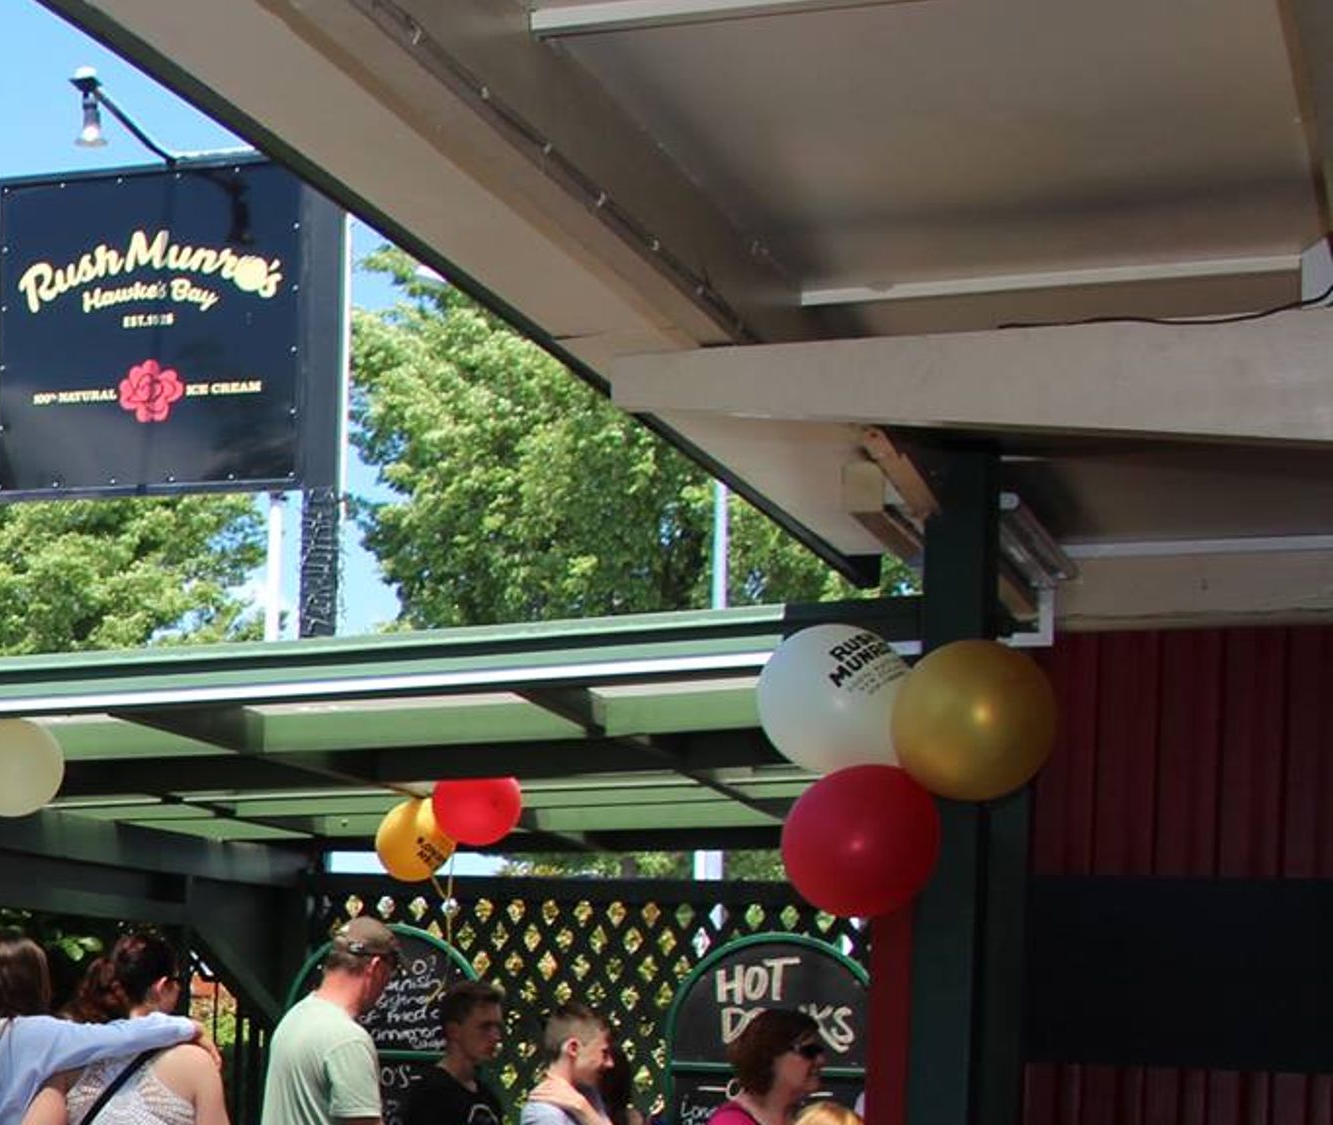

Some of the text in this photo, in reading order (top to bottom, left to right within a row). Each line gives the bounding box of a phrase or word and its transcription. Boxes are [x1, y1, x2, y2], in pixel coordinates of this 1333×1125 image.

[18, 229, 284, 314] Rush Munro's
[82, 277, 220, 314] Hawke's Bay
[57, 388, 118, 403] NATURAL
[185, 383, 209, 397] ICE
[210, 380, 263, 395] CREAM
[716, 956, 802, 1005] HOT
[719, 1003, 856, 1053] DKS
